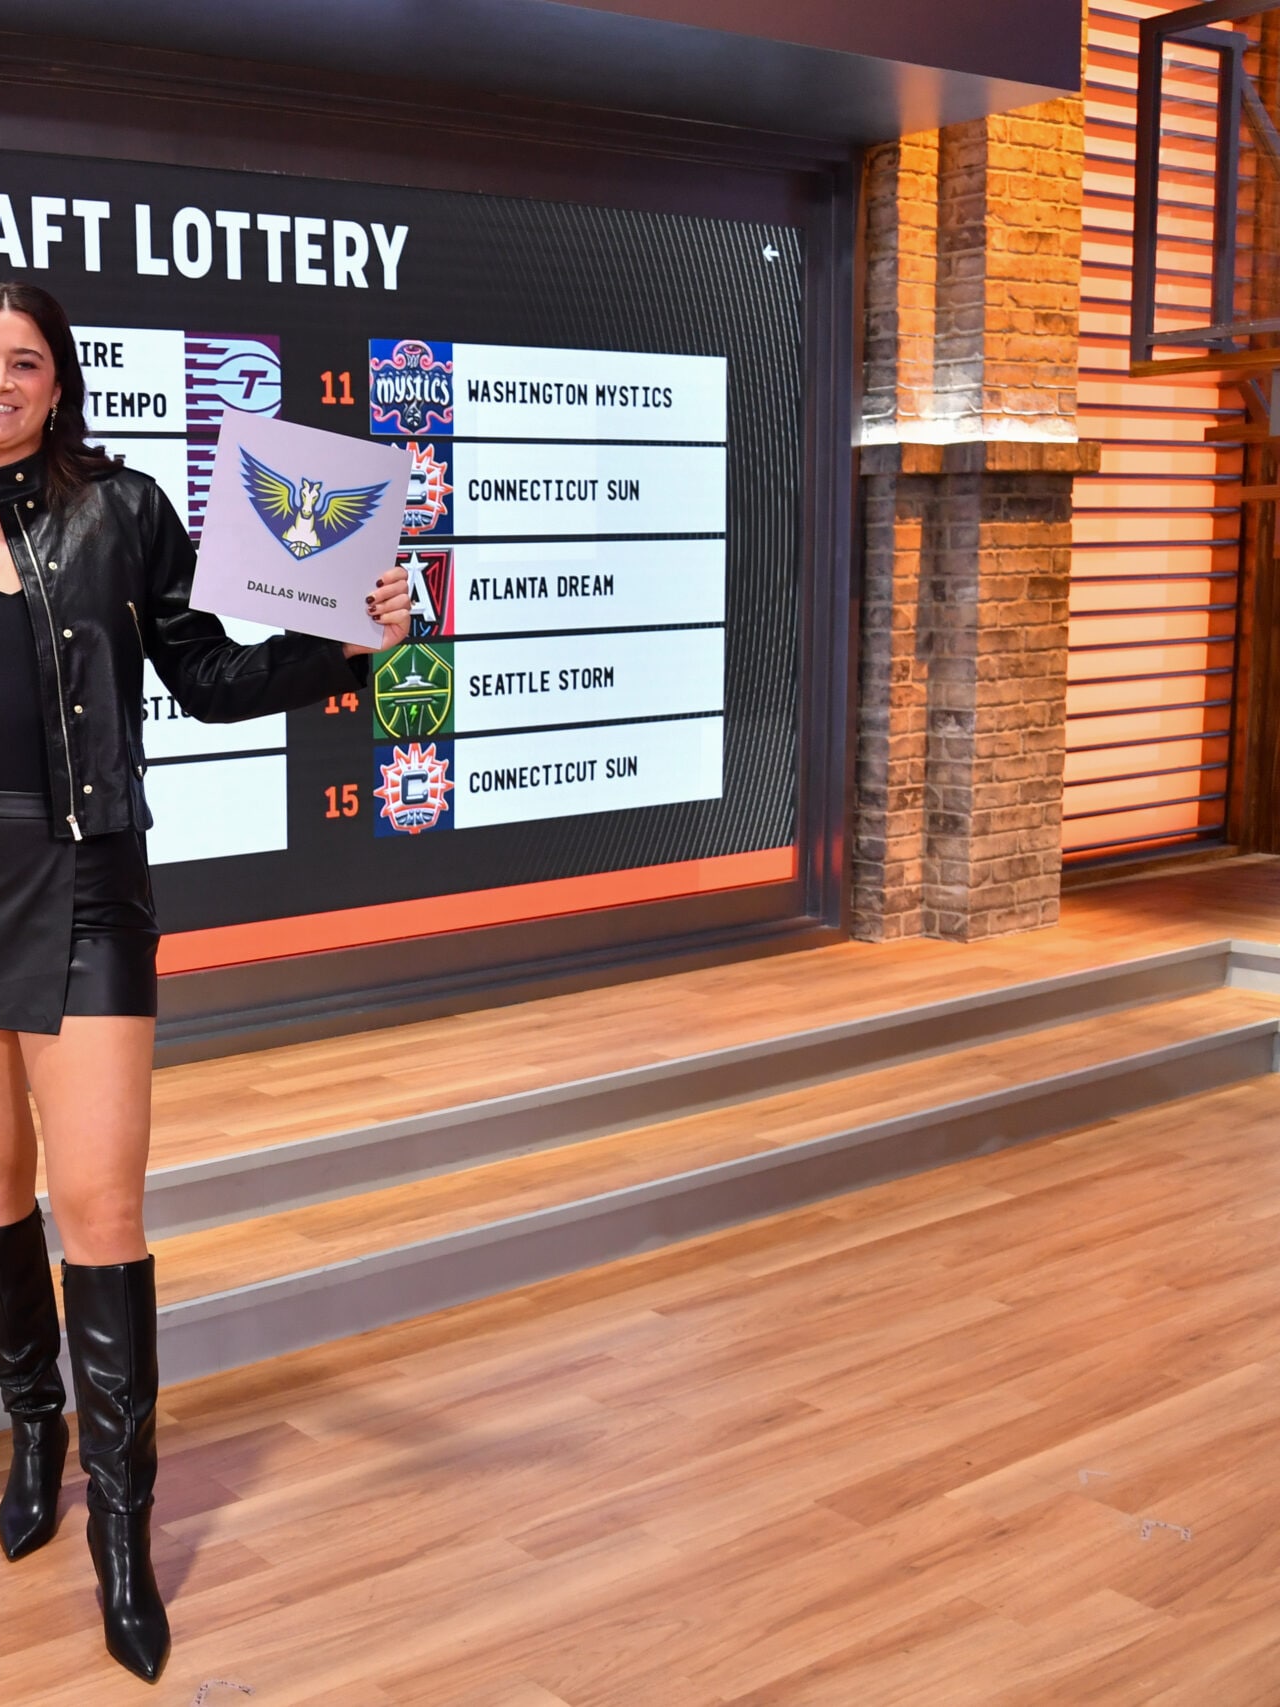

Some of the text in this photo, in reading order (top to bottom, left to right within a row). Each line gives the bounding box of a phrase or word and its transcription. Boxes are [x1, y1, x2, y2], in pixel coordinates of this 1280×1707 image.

[135, 203, 409, 290] LOTTERY
[79, 341, 124, 368] IRE
[238, 370, 268, 400] T
[320, 371, 356, 405] 11
[467, 379, 673, 408] WASHINGTON MYSTICS
[88, 391, 167, 418] TEMPO
[468, 479, 640, 502] CONNECTICUT SUN
[247, 580, 337, 609] DALLAS WINGS
[469, 574, 614, 601] ATLANTA DREAM
[469, 666, 614, 697] SEATTLE STORM
[401, 770, 428, 805] C
[469, 756, 638, 793] CONNECTICUT SUN
[324, 784, 360, 818] 15
